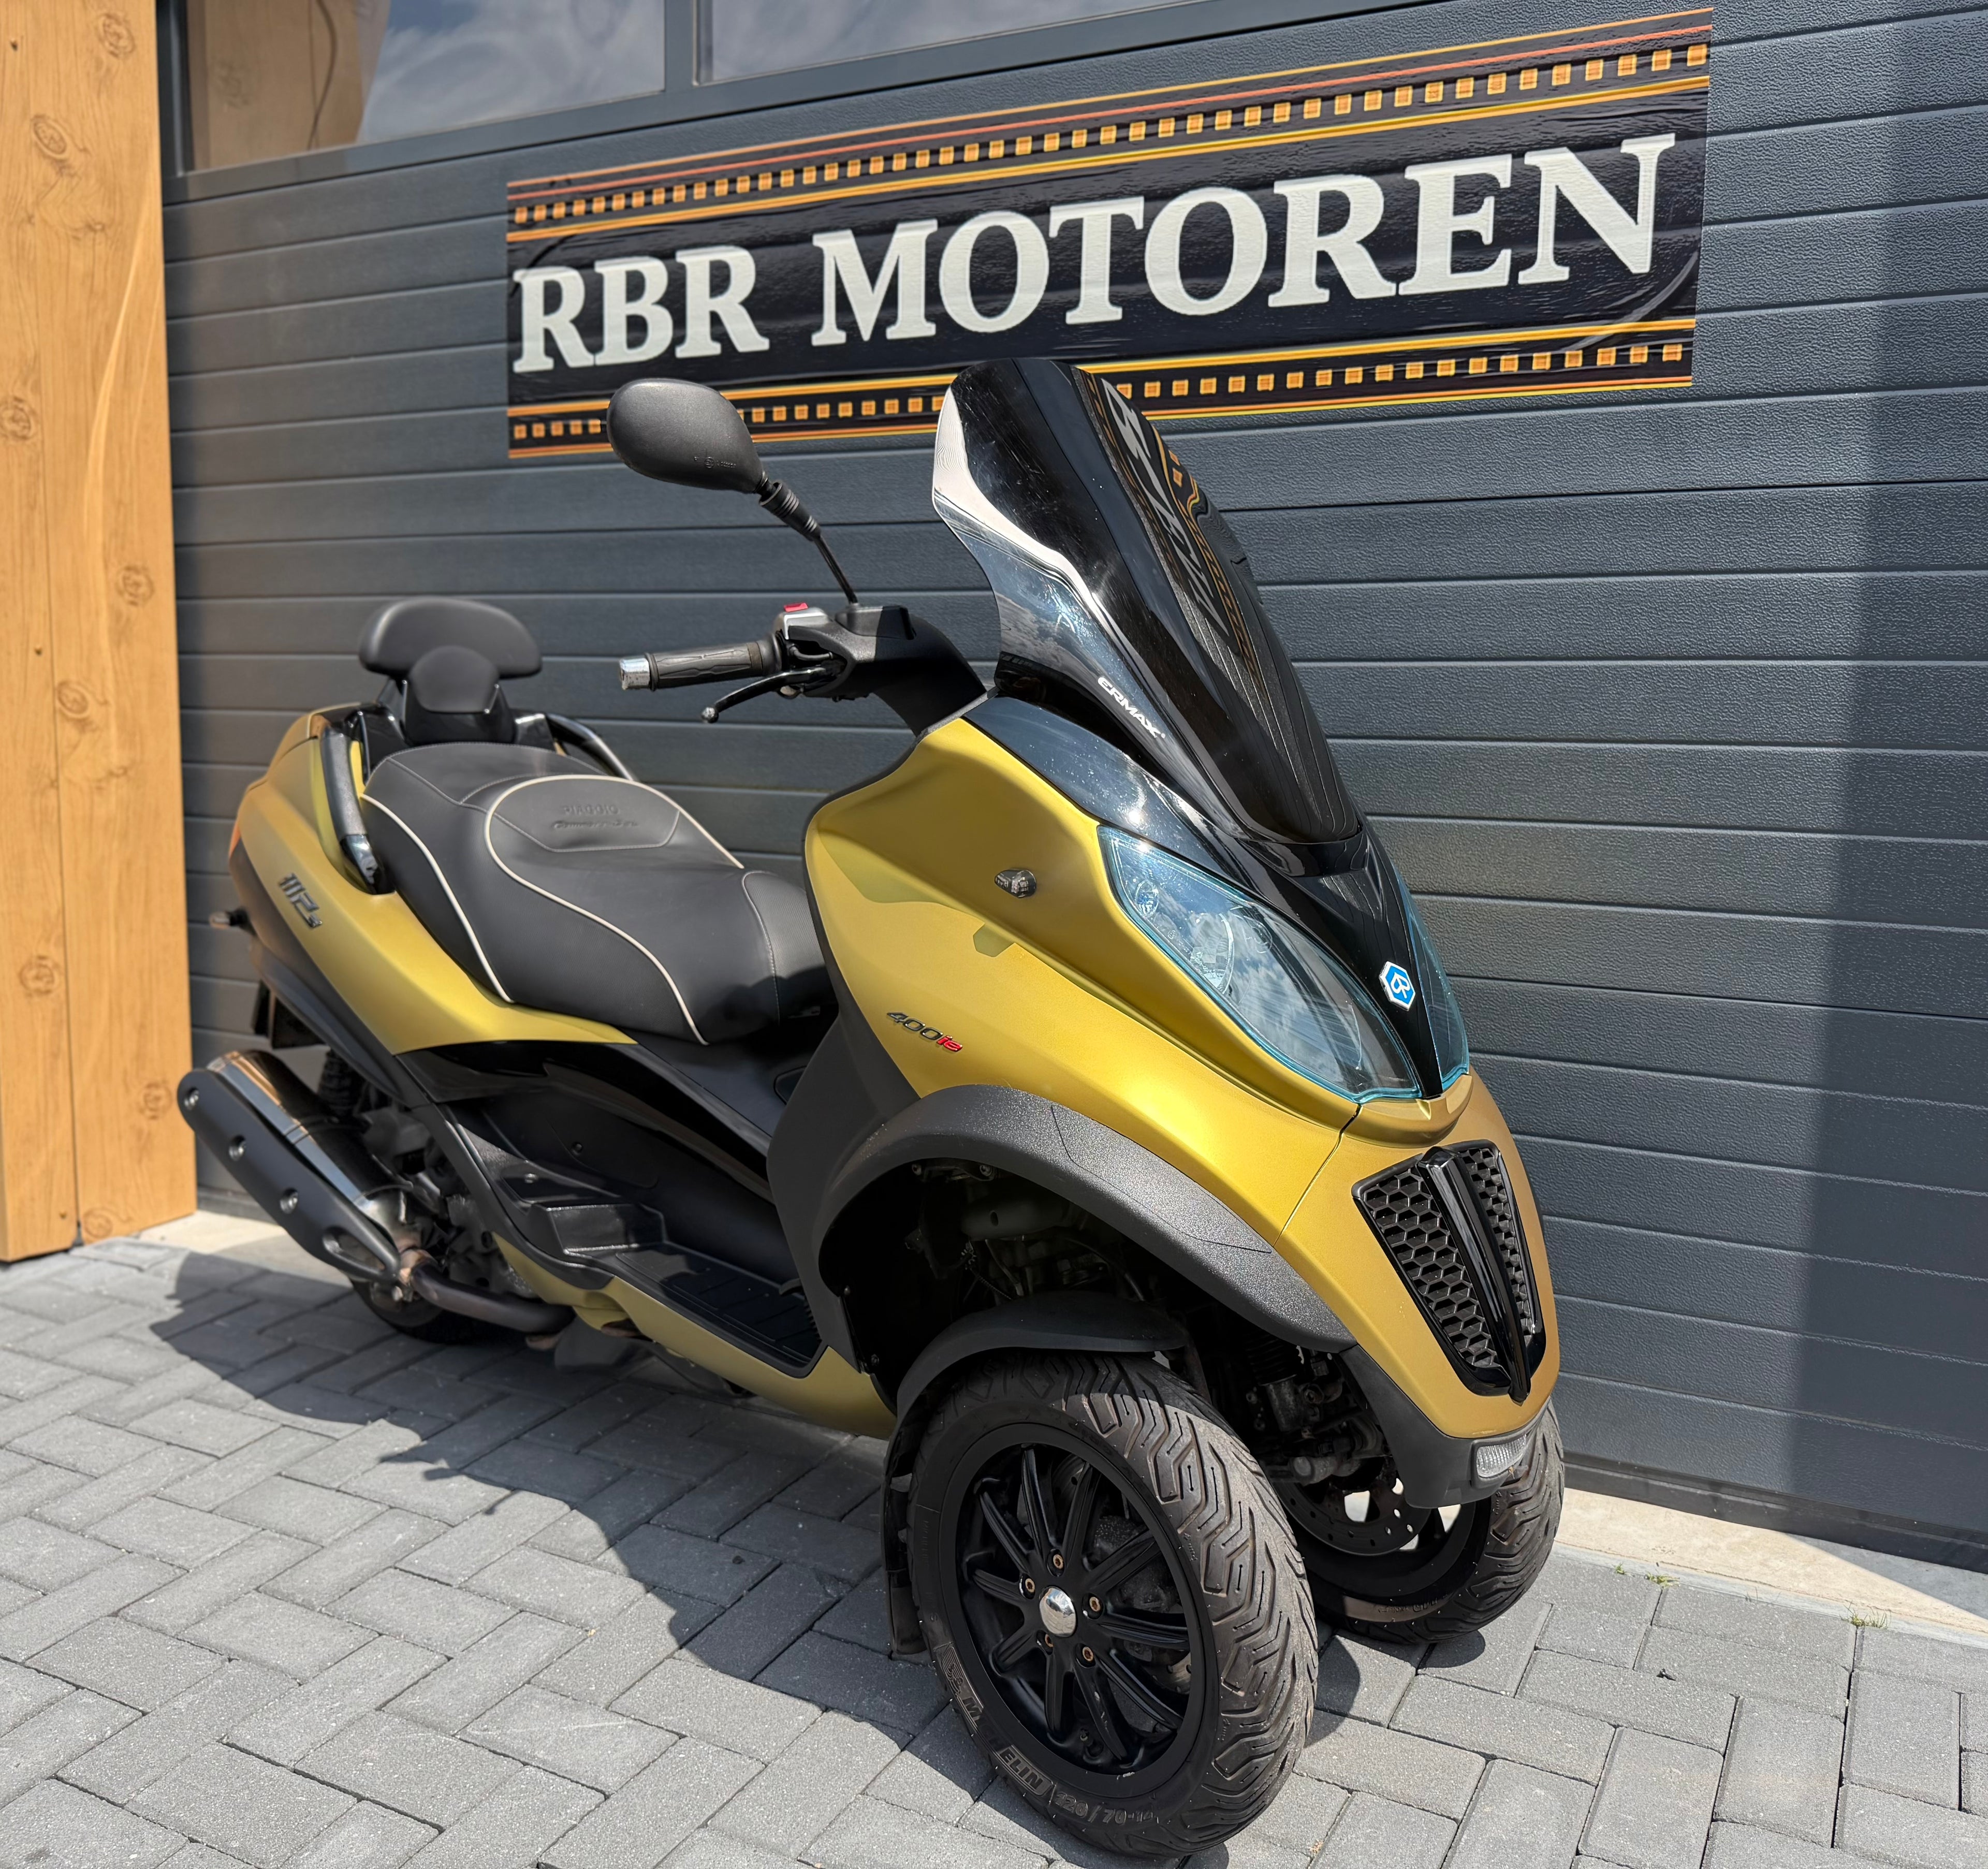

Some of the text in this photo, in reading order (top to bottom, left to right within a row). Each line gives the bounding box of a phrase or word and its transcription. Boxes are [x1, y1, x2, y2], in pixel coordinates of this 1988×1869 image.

[513, 133, 1676, 373] RBR MOTOREN
[1098, 677, 1161, 738] ERMAX
